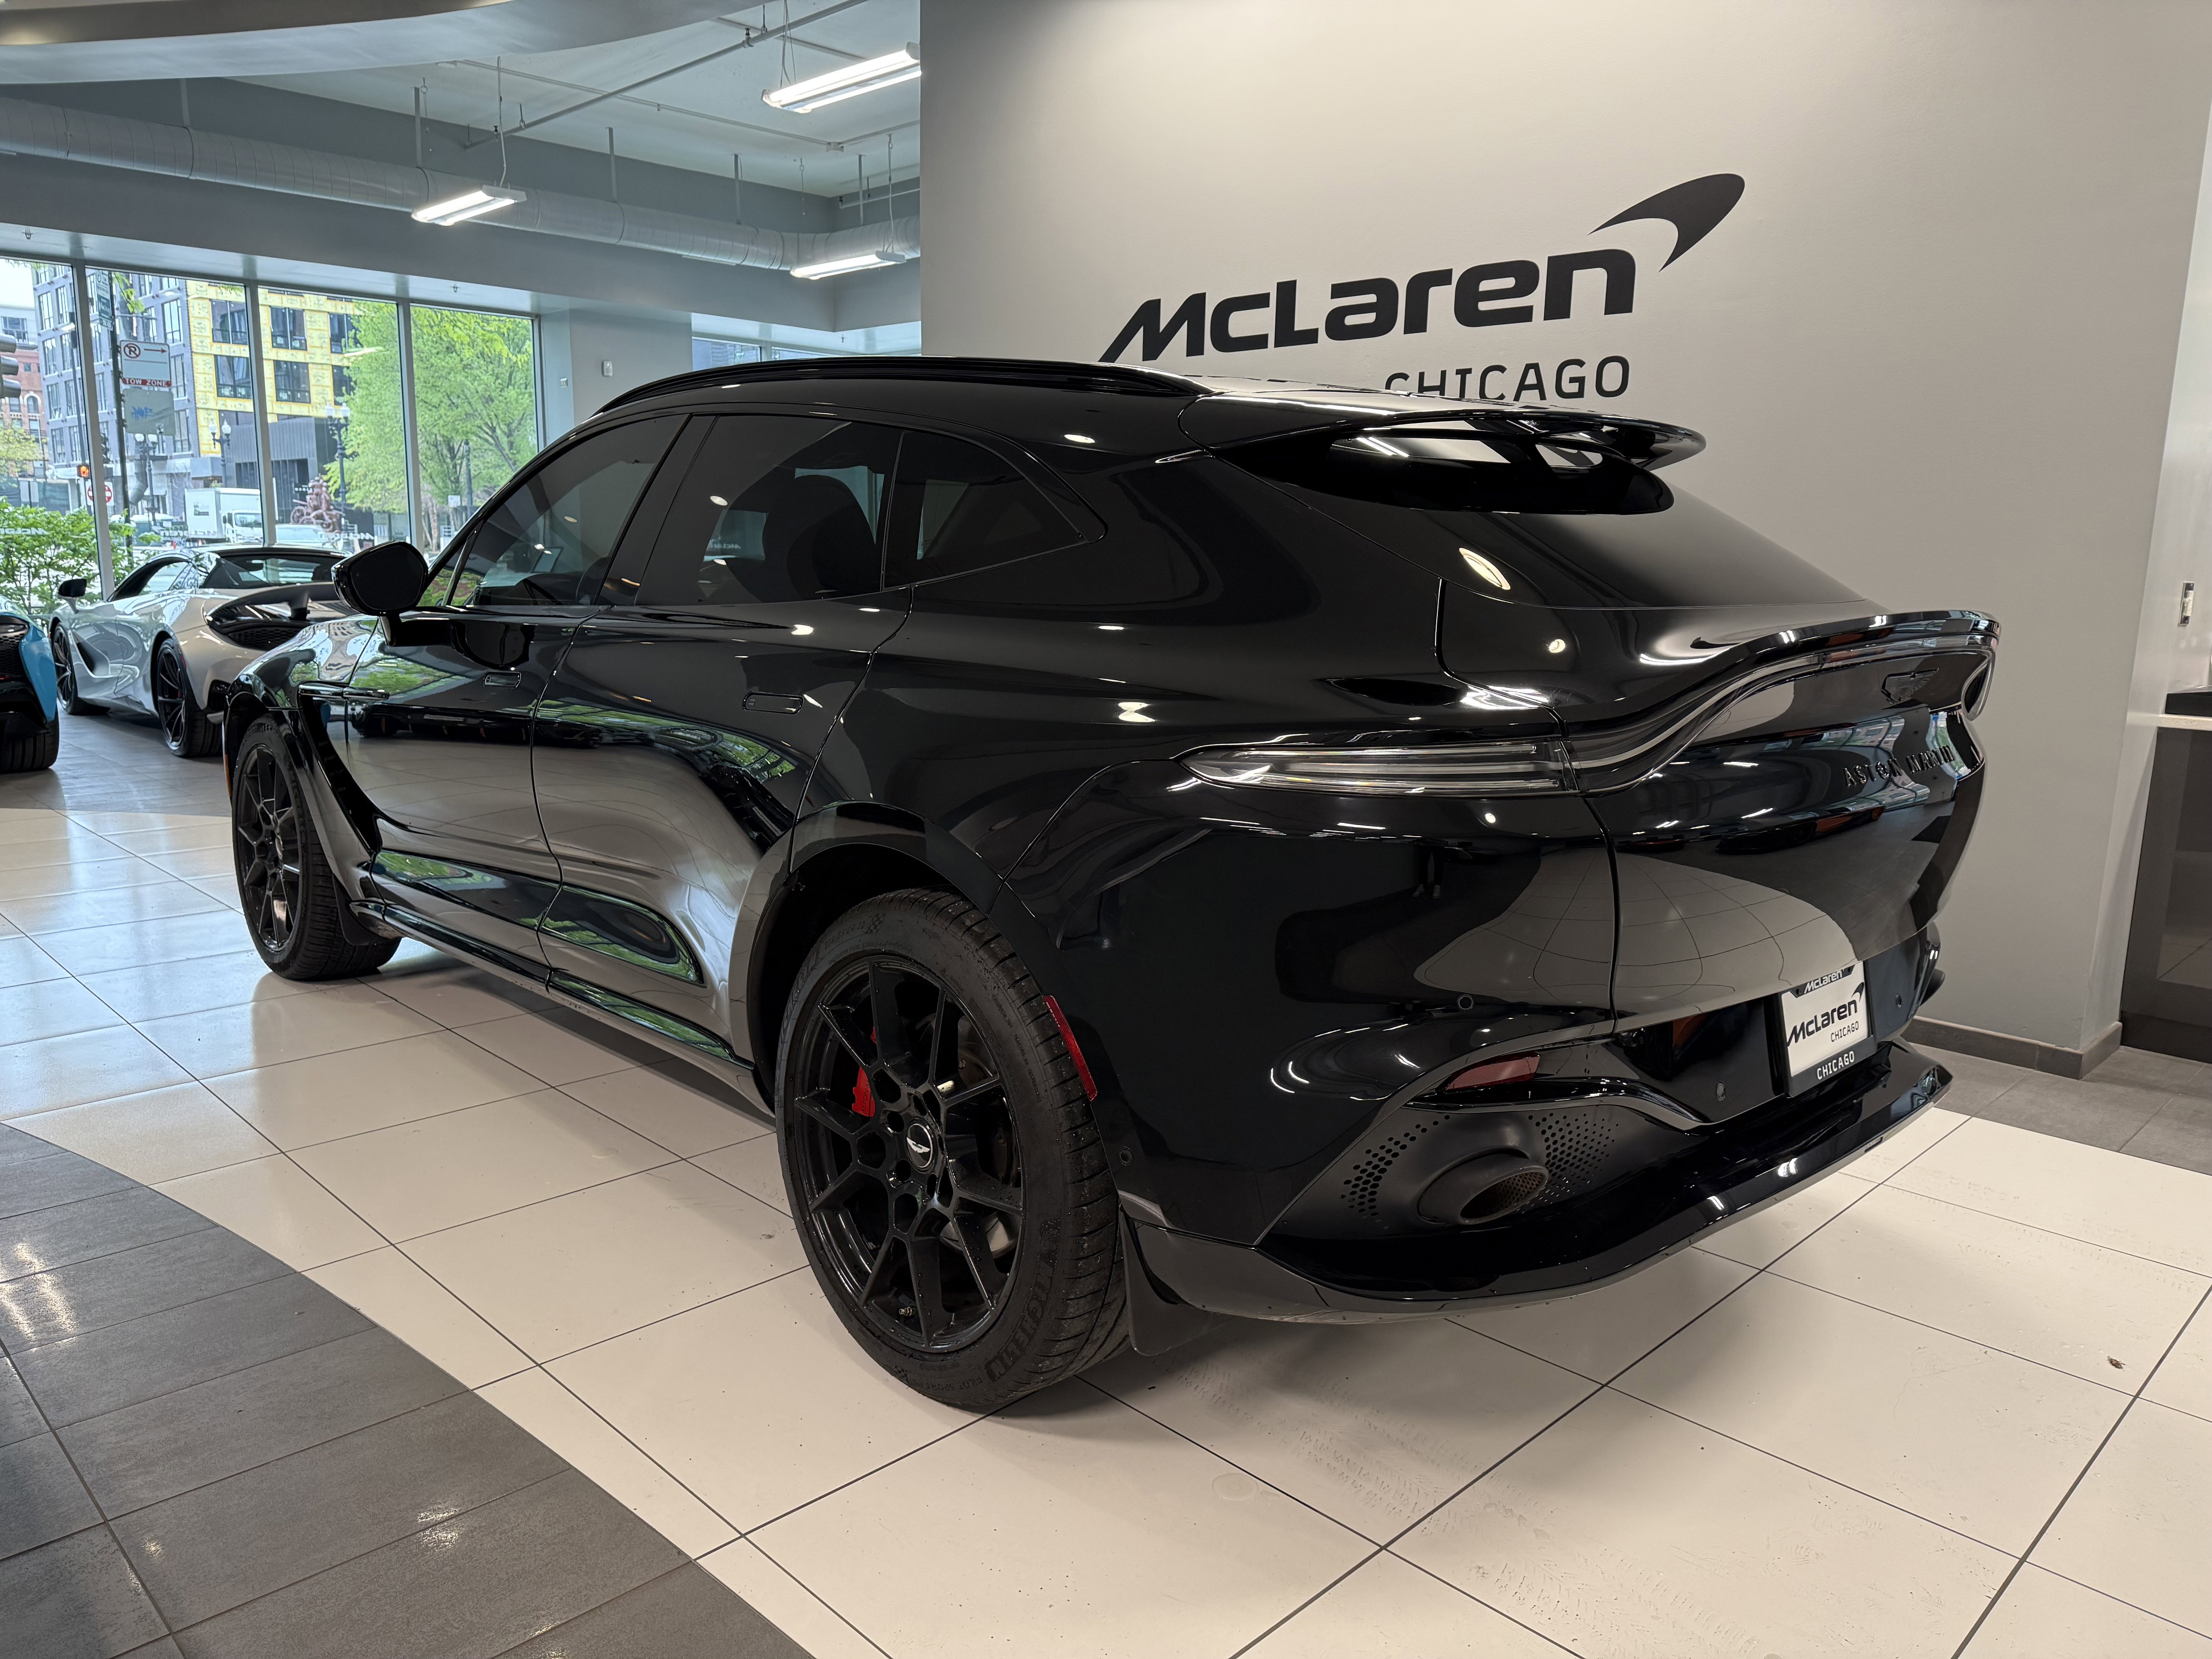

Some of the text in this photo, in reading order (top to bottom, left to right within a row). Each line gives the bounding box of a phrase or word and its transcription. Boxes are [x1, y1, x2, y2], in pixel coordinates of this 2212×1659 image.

[1097, 248, 1636, 363] McLaren
[1843, 744, 1955, 789] ASTON MARTIN
[1803, 969, 1844, 994] McLaren
[1787, 999, 1858, 1047] McLaren
[1831, 1020, 1859, 1042] CHICAGO
[1816, 1051, 1855, 1080] CHICAGO
[958, 1376, 983, 1390] PILOT
